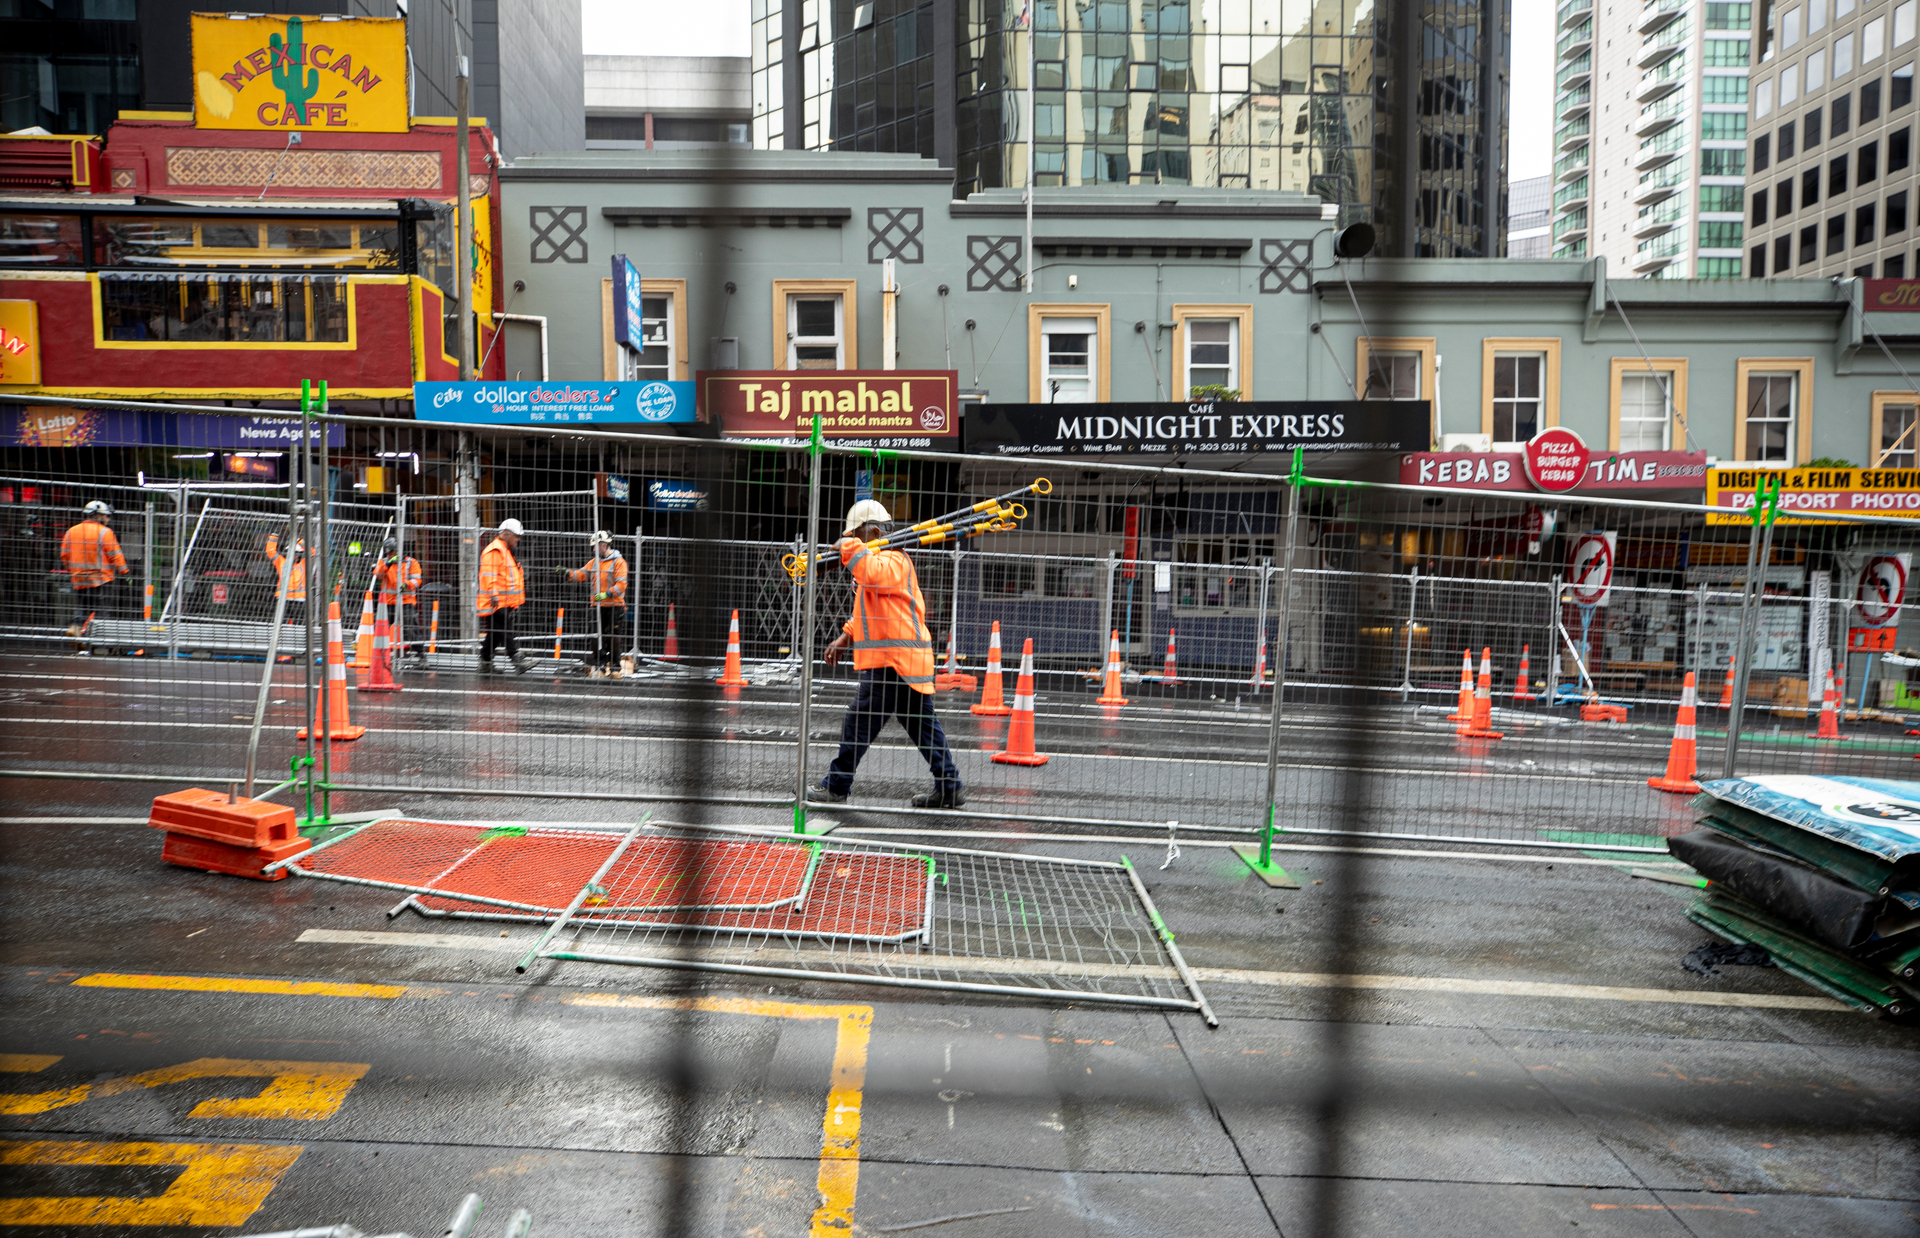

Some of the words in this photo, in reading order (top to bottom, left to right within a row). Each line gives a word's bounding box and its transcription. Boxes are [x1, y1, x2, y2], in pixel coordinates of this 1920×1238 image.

[220, 43, 382, 93] MEXICAN
[257, 90, 348, 126] CAFÉ
[433, 388, 464, 408] City
[739, 381, 791, 421] Taj
[801, 381, 914, 413] mahal
[492, 404, 505, 413] 24
[37, 415, 76, 430] Lotto
[838, 415, 866, 426] food
[868, 417, 913, 427] mantra
[1055, 415, 1222, 440] MIDNIGHT
[1230, 414, 1345, 438] EXPRESS
[240, 426, 277, 438] News
[837, 438, 873, 447] Contact
[879, 438, 891, 447] 09
[891, 438, 908, 447] 379
[1199, 443, 1219, 451] 303
[1221, 443, 1248, 451] 0312
[1541, 442, 1576, 455] PIZZA
[1537, 455, 1581, 468] BURGER
[1418, 458, 1512, 484] KEBAB
[1540, 469, 1576, 482] KEBAB
[1792, 475, 1804, 487] &
[1808, 472, 1852, 488] FILM
[1860, 471, 1920, 488] SERVI
